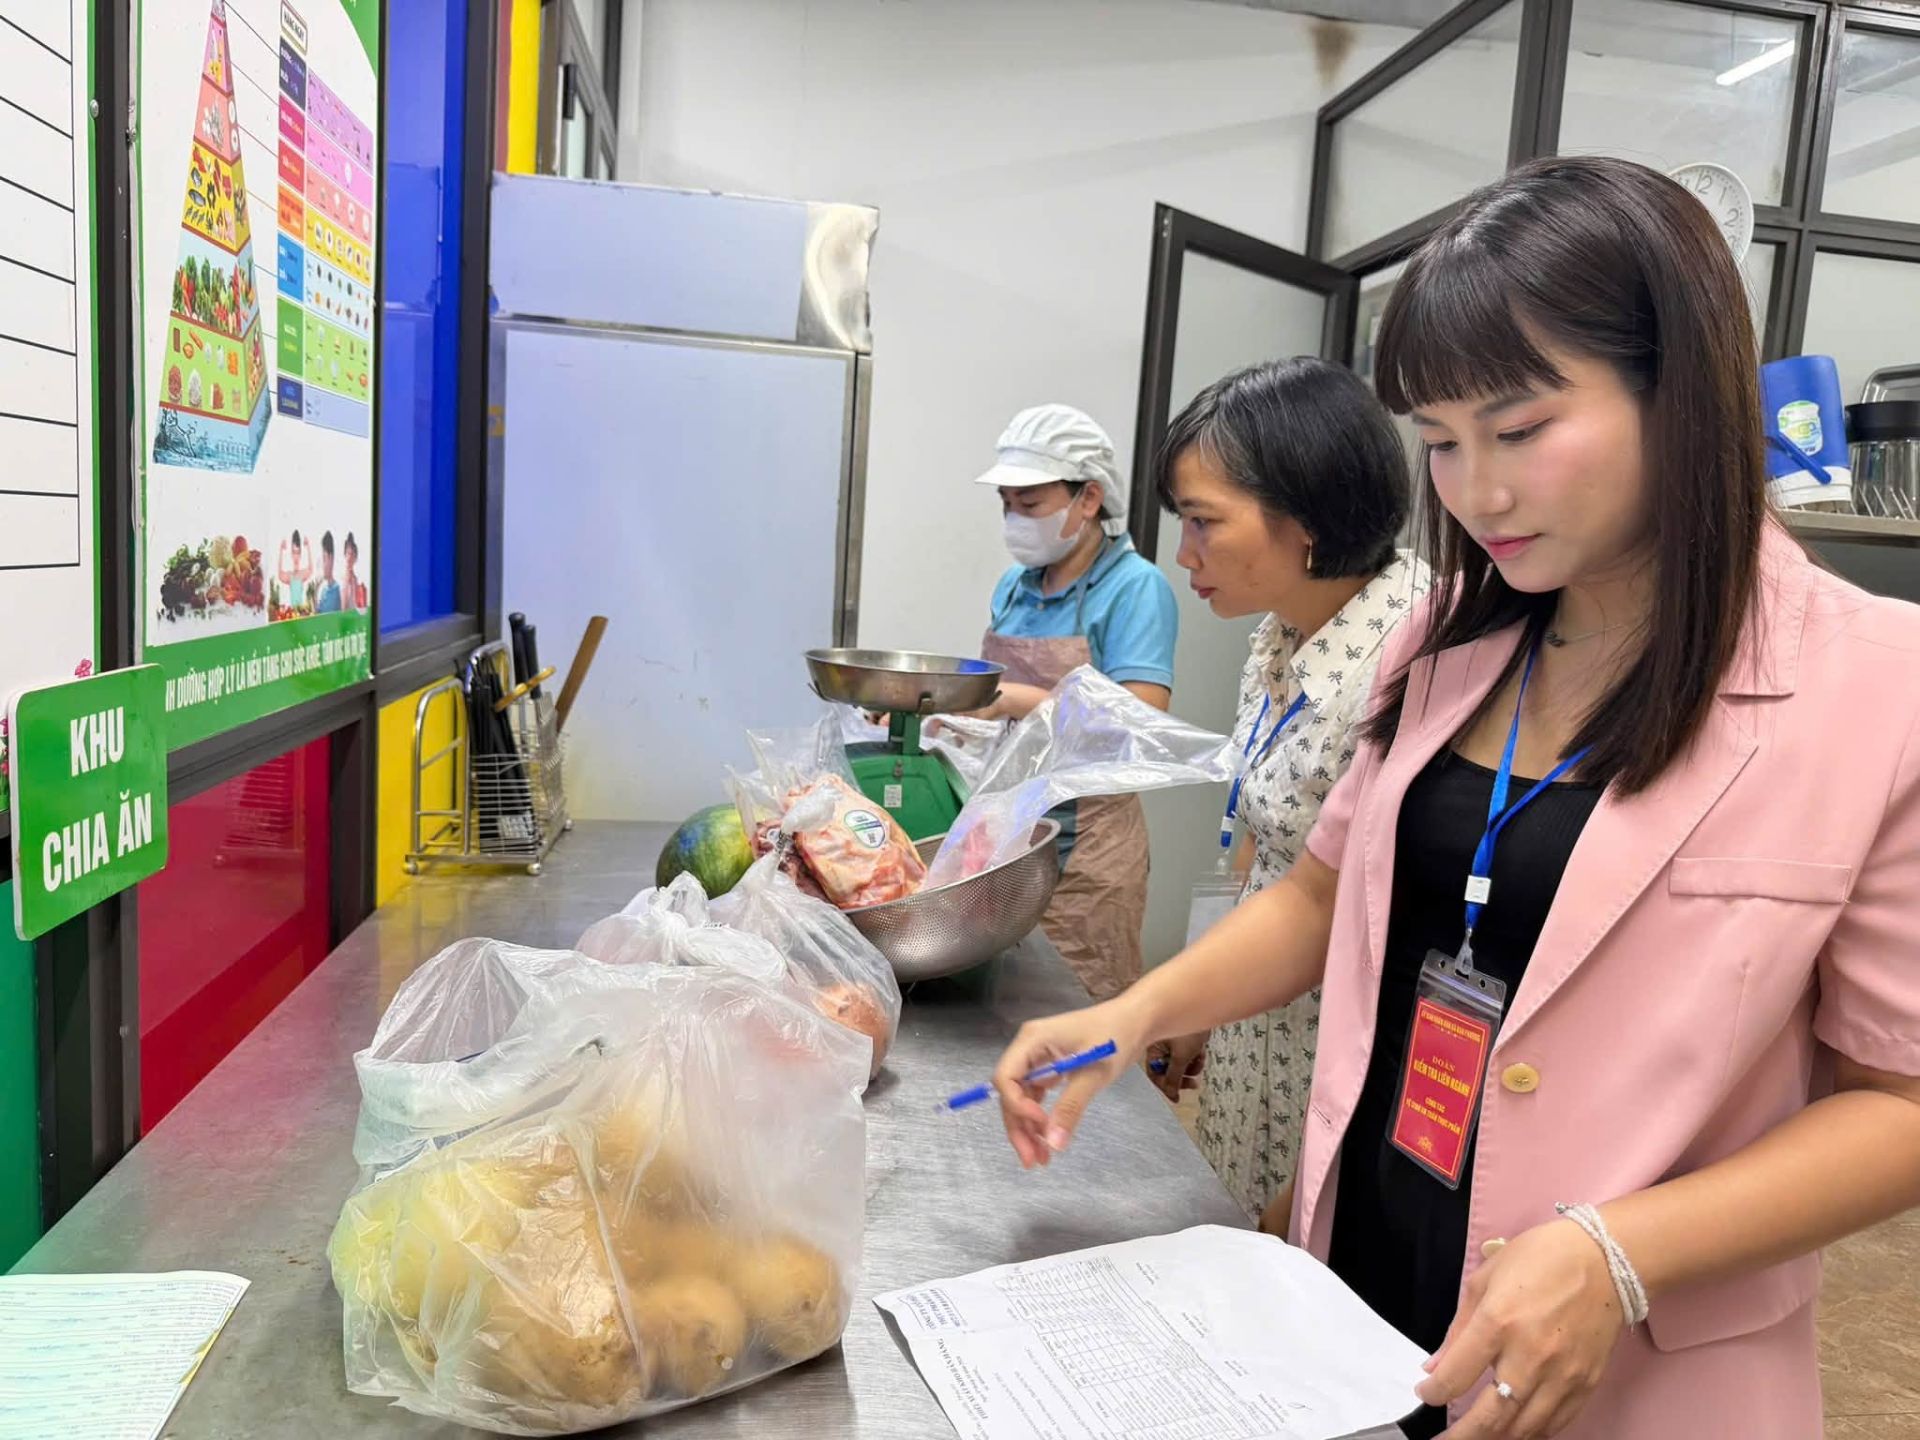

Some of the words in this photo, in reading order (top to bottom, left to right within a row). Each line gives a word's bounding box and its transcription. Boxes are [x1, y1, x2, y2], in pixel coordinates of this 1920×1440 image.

[1723, 207, 1740, 227] 2
[177, 667, 206, 709] DƯỠNG
[207, 665, 225, 706] HỢP
[70, 706, 125, 777] KHU
[42, 811, 110, 893] CHIA
[117, 788, 152, 858] ĂN
